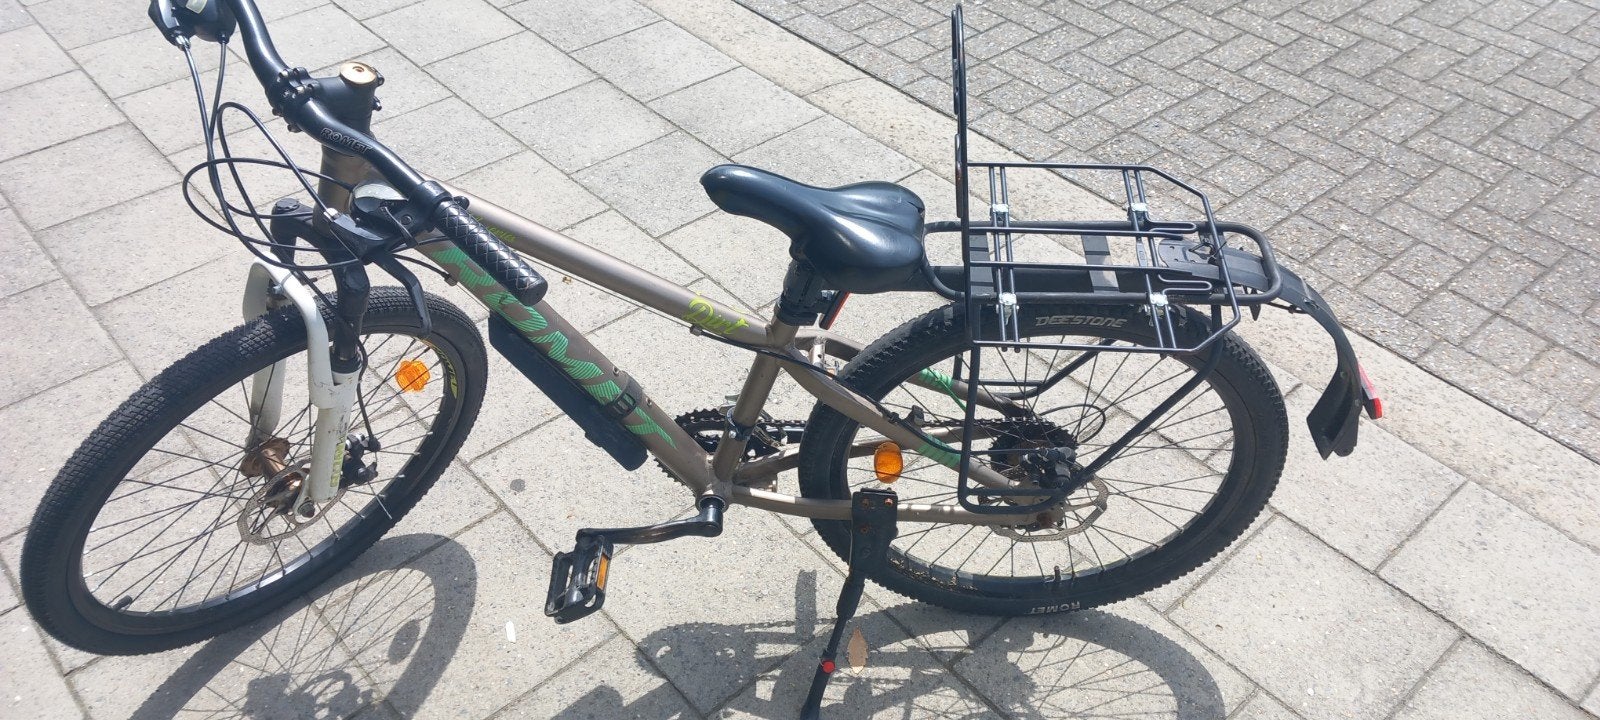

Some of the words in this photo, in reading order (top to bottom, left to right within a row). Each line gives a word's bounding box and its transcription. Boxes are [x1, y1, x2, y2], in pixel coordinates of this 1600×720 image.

[320, 127, 374, 154] ROMET
[1035, 315, 1128, 328] DEESTONE
[1027, 601, 1080, 614] ROMET
